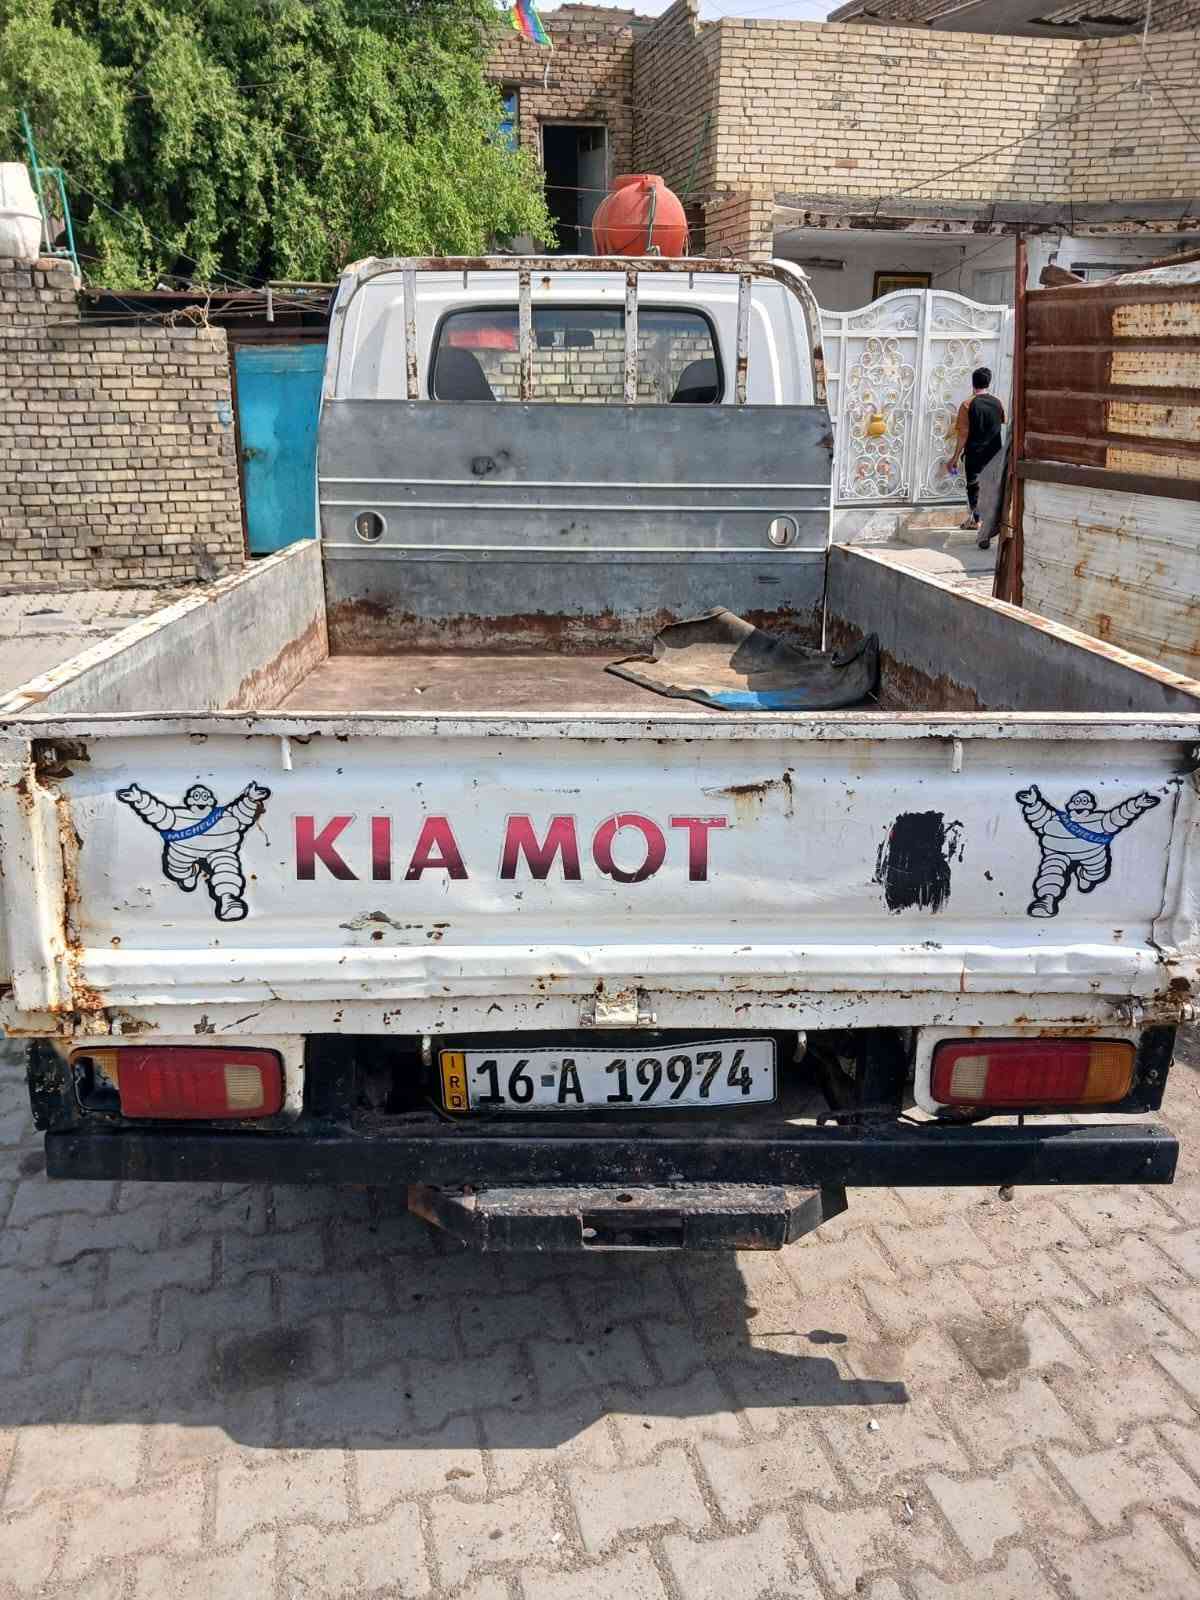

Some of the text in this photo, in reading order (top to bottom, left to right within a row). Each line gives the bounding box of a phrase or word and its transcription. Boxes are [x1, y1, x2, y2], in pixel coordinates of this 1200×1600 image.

[166, 807, 223, 840] MICHELIN
[294, 811, 728, 884] KIA MOT
[605, 1049, 753, 1103] 19974
